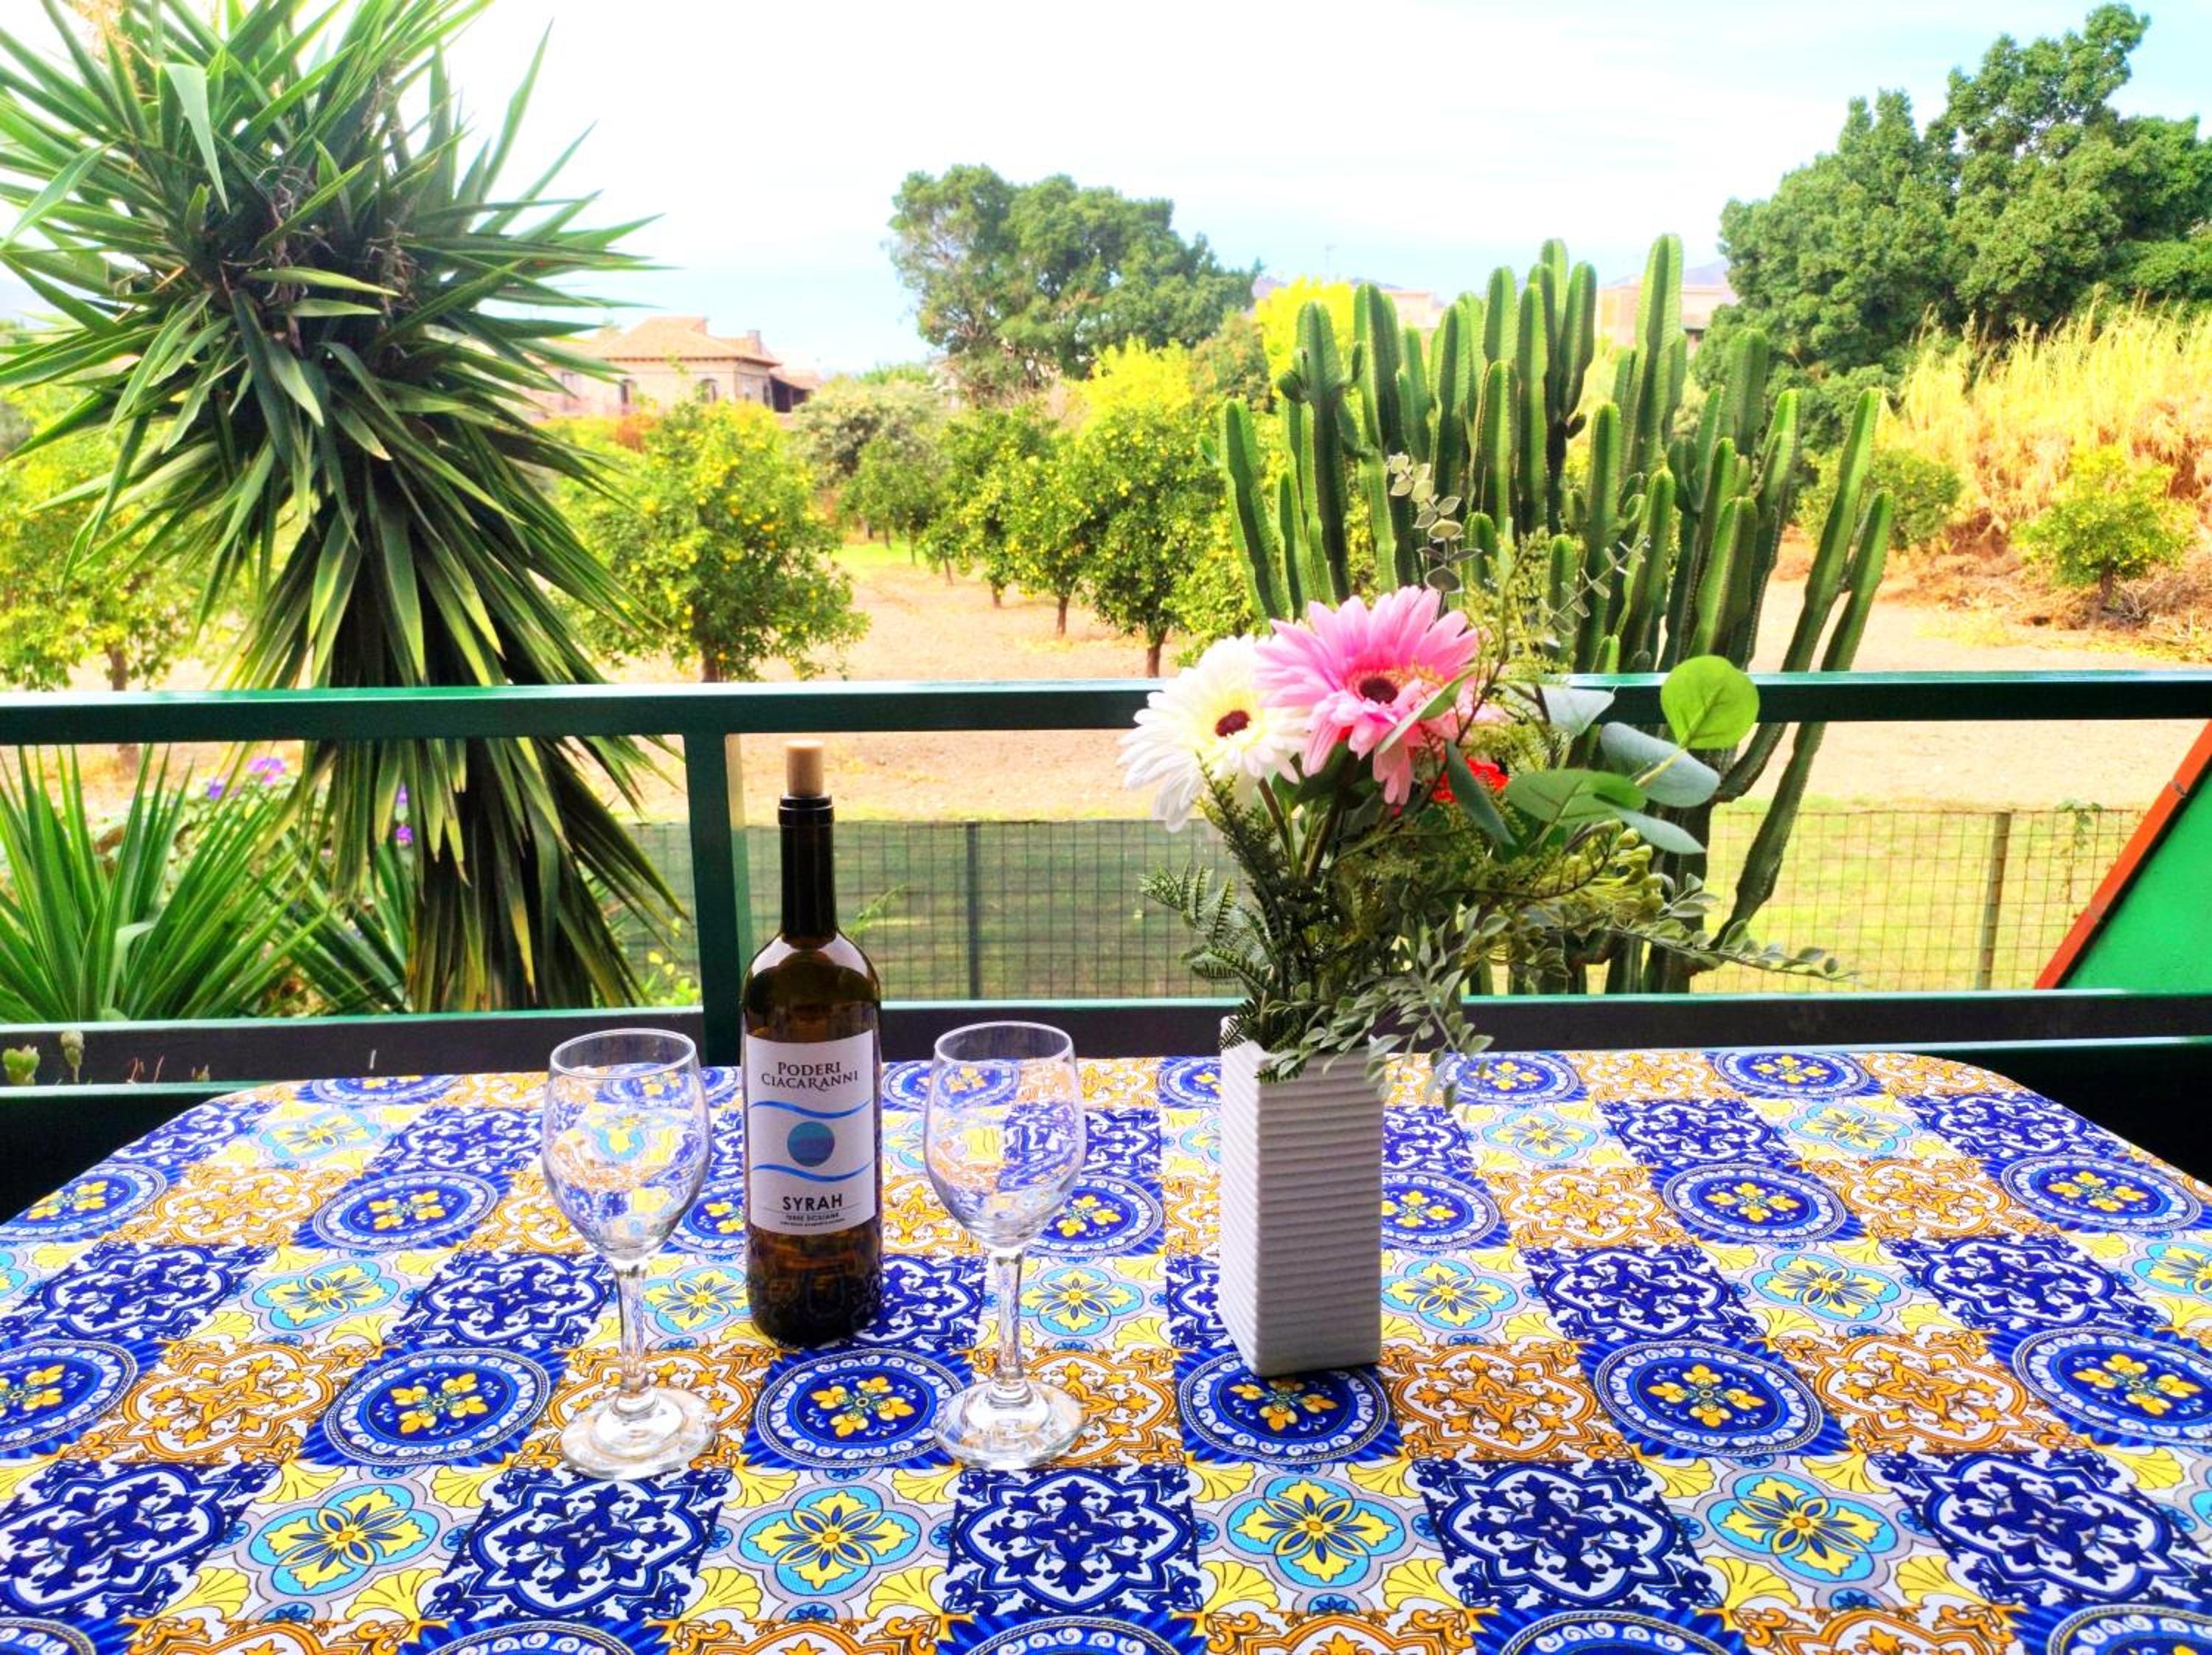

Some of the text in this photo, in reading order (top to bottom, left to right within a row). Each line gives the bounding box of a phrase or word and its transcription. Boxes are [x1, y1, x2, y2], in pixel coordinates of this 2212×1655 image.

[778, 1062, 841, 1076] PODERI
[761, 1071, 858, 1092] CIACARANNI
[782, 1193, 843, 1211] SYRAH
